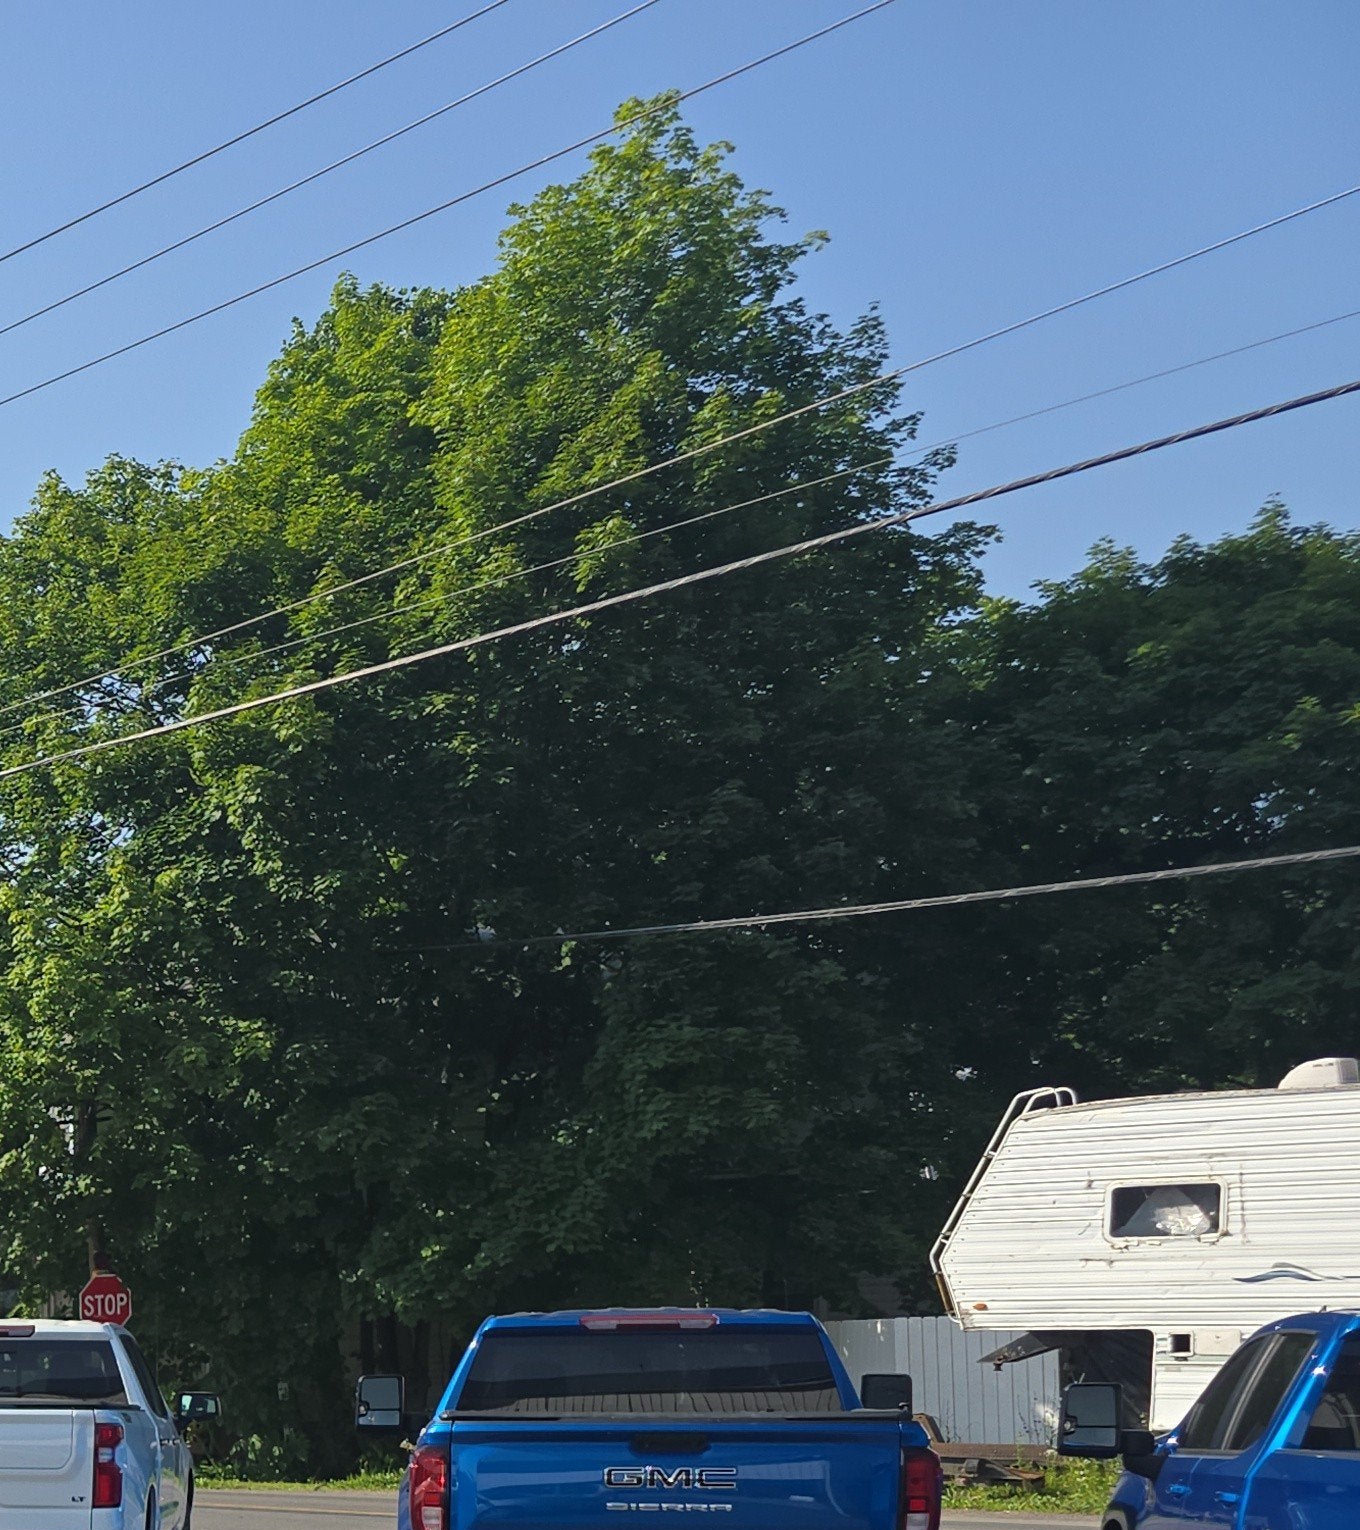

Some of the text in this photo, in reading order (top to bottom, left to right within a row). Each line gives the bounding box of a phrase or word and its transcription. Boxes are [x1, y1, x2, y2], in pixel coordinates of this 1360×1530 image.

[84, 1293, 128, 1317] STOP
[604, 1466, 737, 1488] GMC
[606, 1502, 733, 1512] SIERRA
